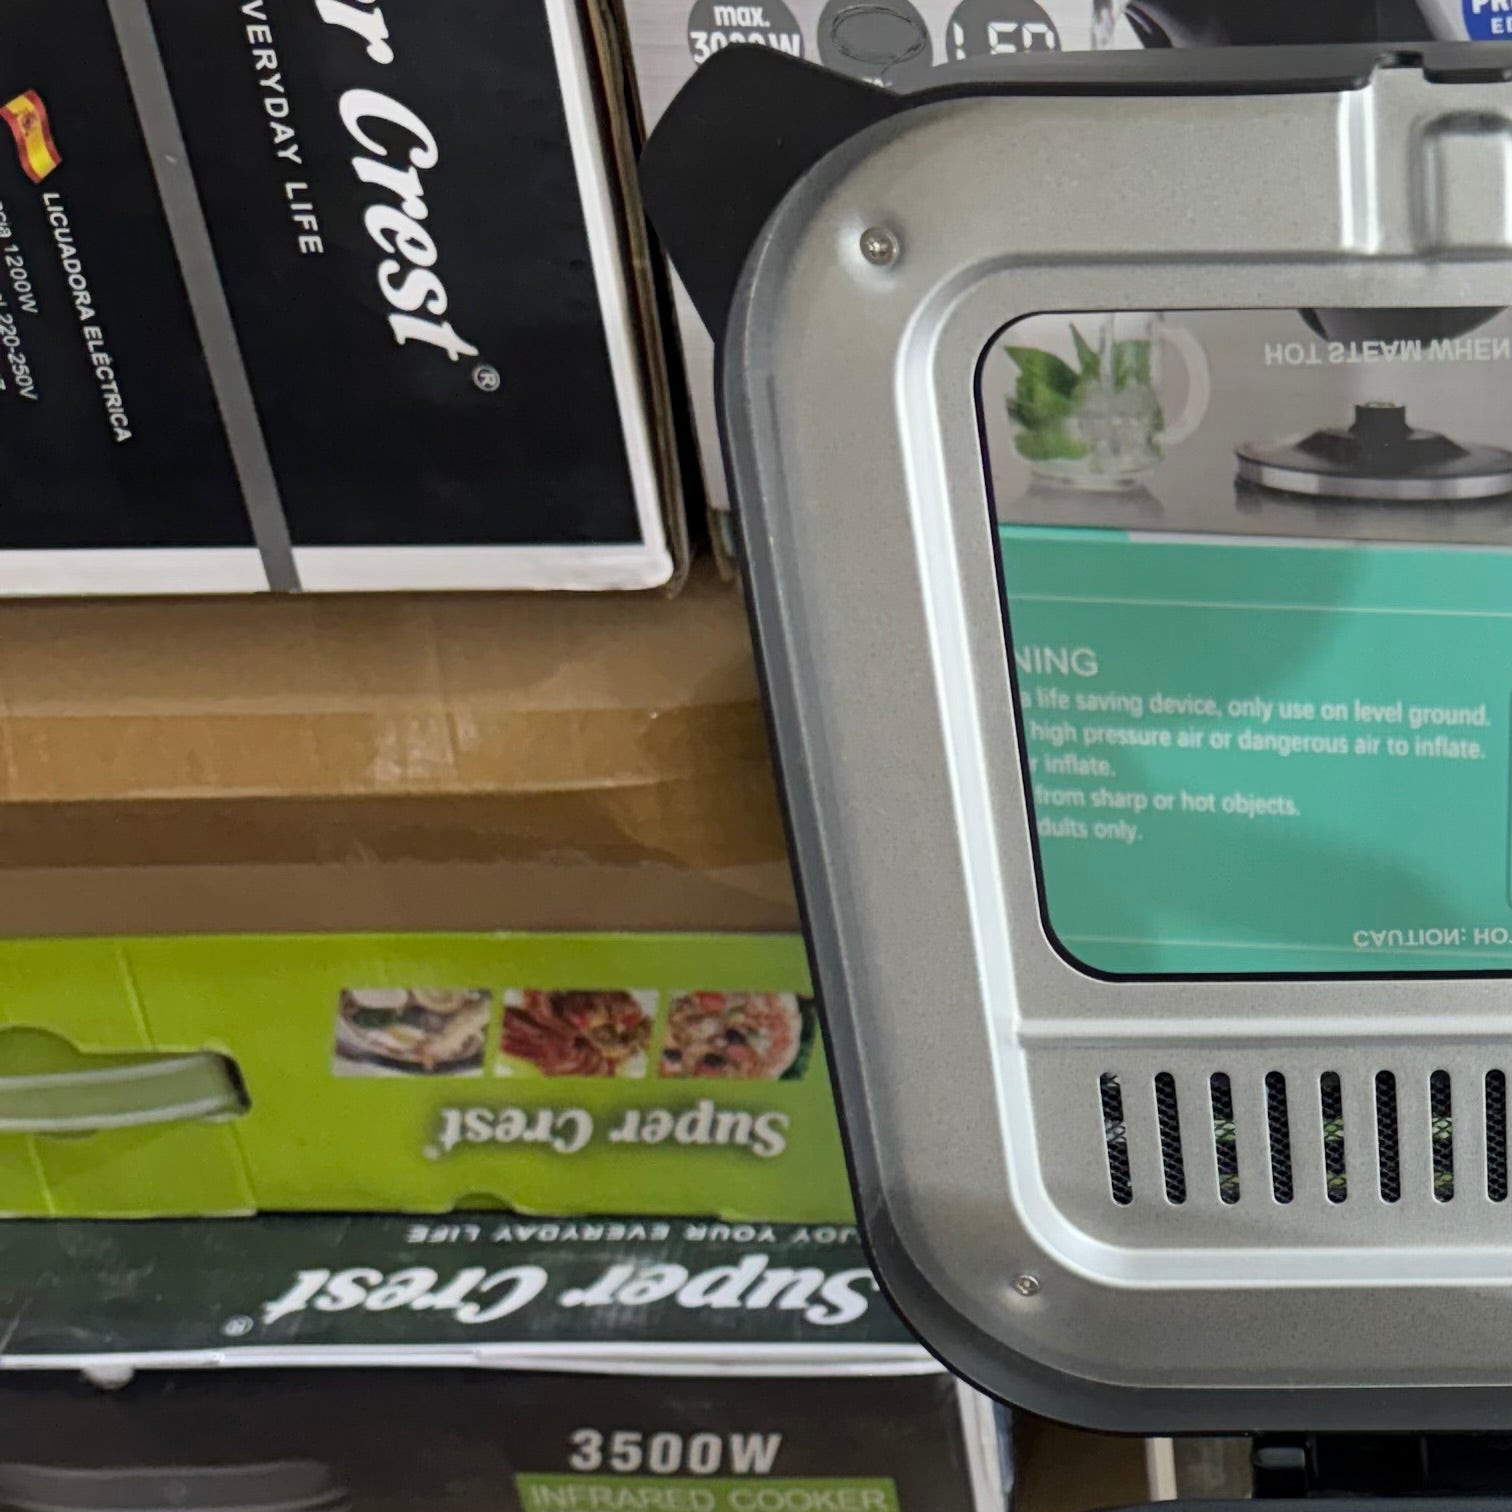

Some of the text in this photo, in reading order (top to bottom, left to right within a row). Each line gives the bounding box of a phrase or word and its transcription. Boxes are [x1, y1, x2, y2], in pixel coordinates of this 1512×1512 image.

[713, 5, 771, 28] max.
[285, 182, 324, 254] LIFE
[339, 88, 479, 361] Crest
[4, 244, 38, 313] 1200W
[43, 193, 132, 442] LICUADORA ELÉCTRICA
[1036, 687, 1070, 709] life
[1076, 691, 1143, 718] saving
[1149, 692, 1222, 718] device,
[1228, 697, 1272, 723] only
[1279, 702, 1314, 720] use
[1320, 703, 1348, 720] on
[1355, 698, 1403, 722] level
[1408, 704, 1491, 730] ground.
[1030, 721, 1486, 759] high pressure air or dangerous air to inflate.
[1045, 753, 1116, 777] inflate.
[1034, 784, 1301, 818] from sharp or hot objects.
[1094, 820, 1143, 846] only.
[441, 1100, 790, 1158] Super Crest
[407, 1224, 481, 1244] LIFE
[495, 1223, 672, 1243] EVERYDAY
[685, 1224, 777, 1243] YOUR
[262, 1254, 880, 1325] Super Crest
[569, 1428, 782, 1474] 3500W
[530, 1484, 888, 1512] INFRARED COOKER
